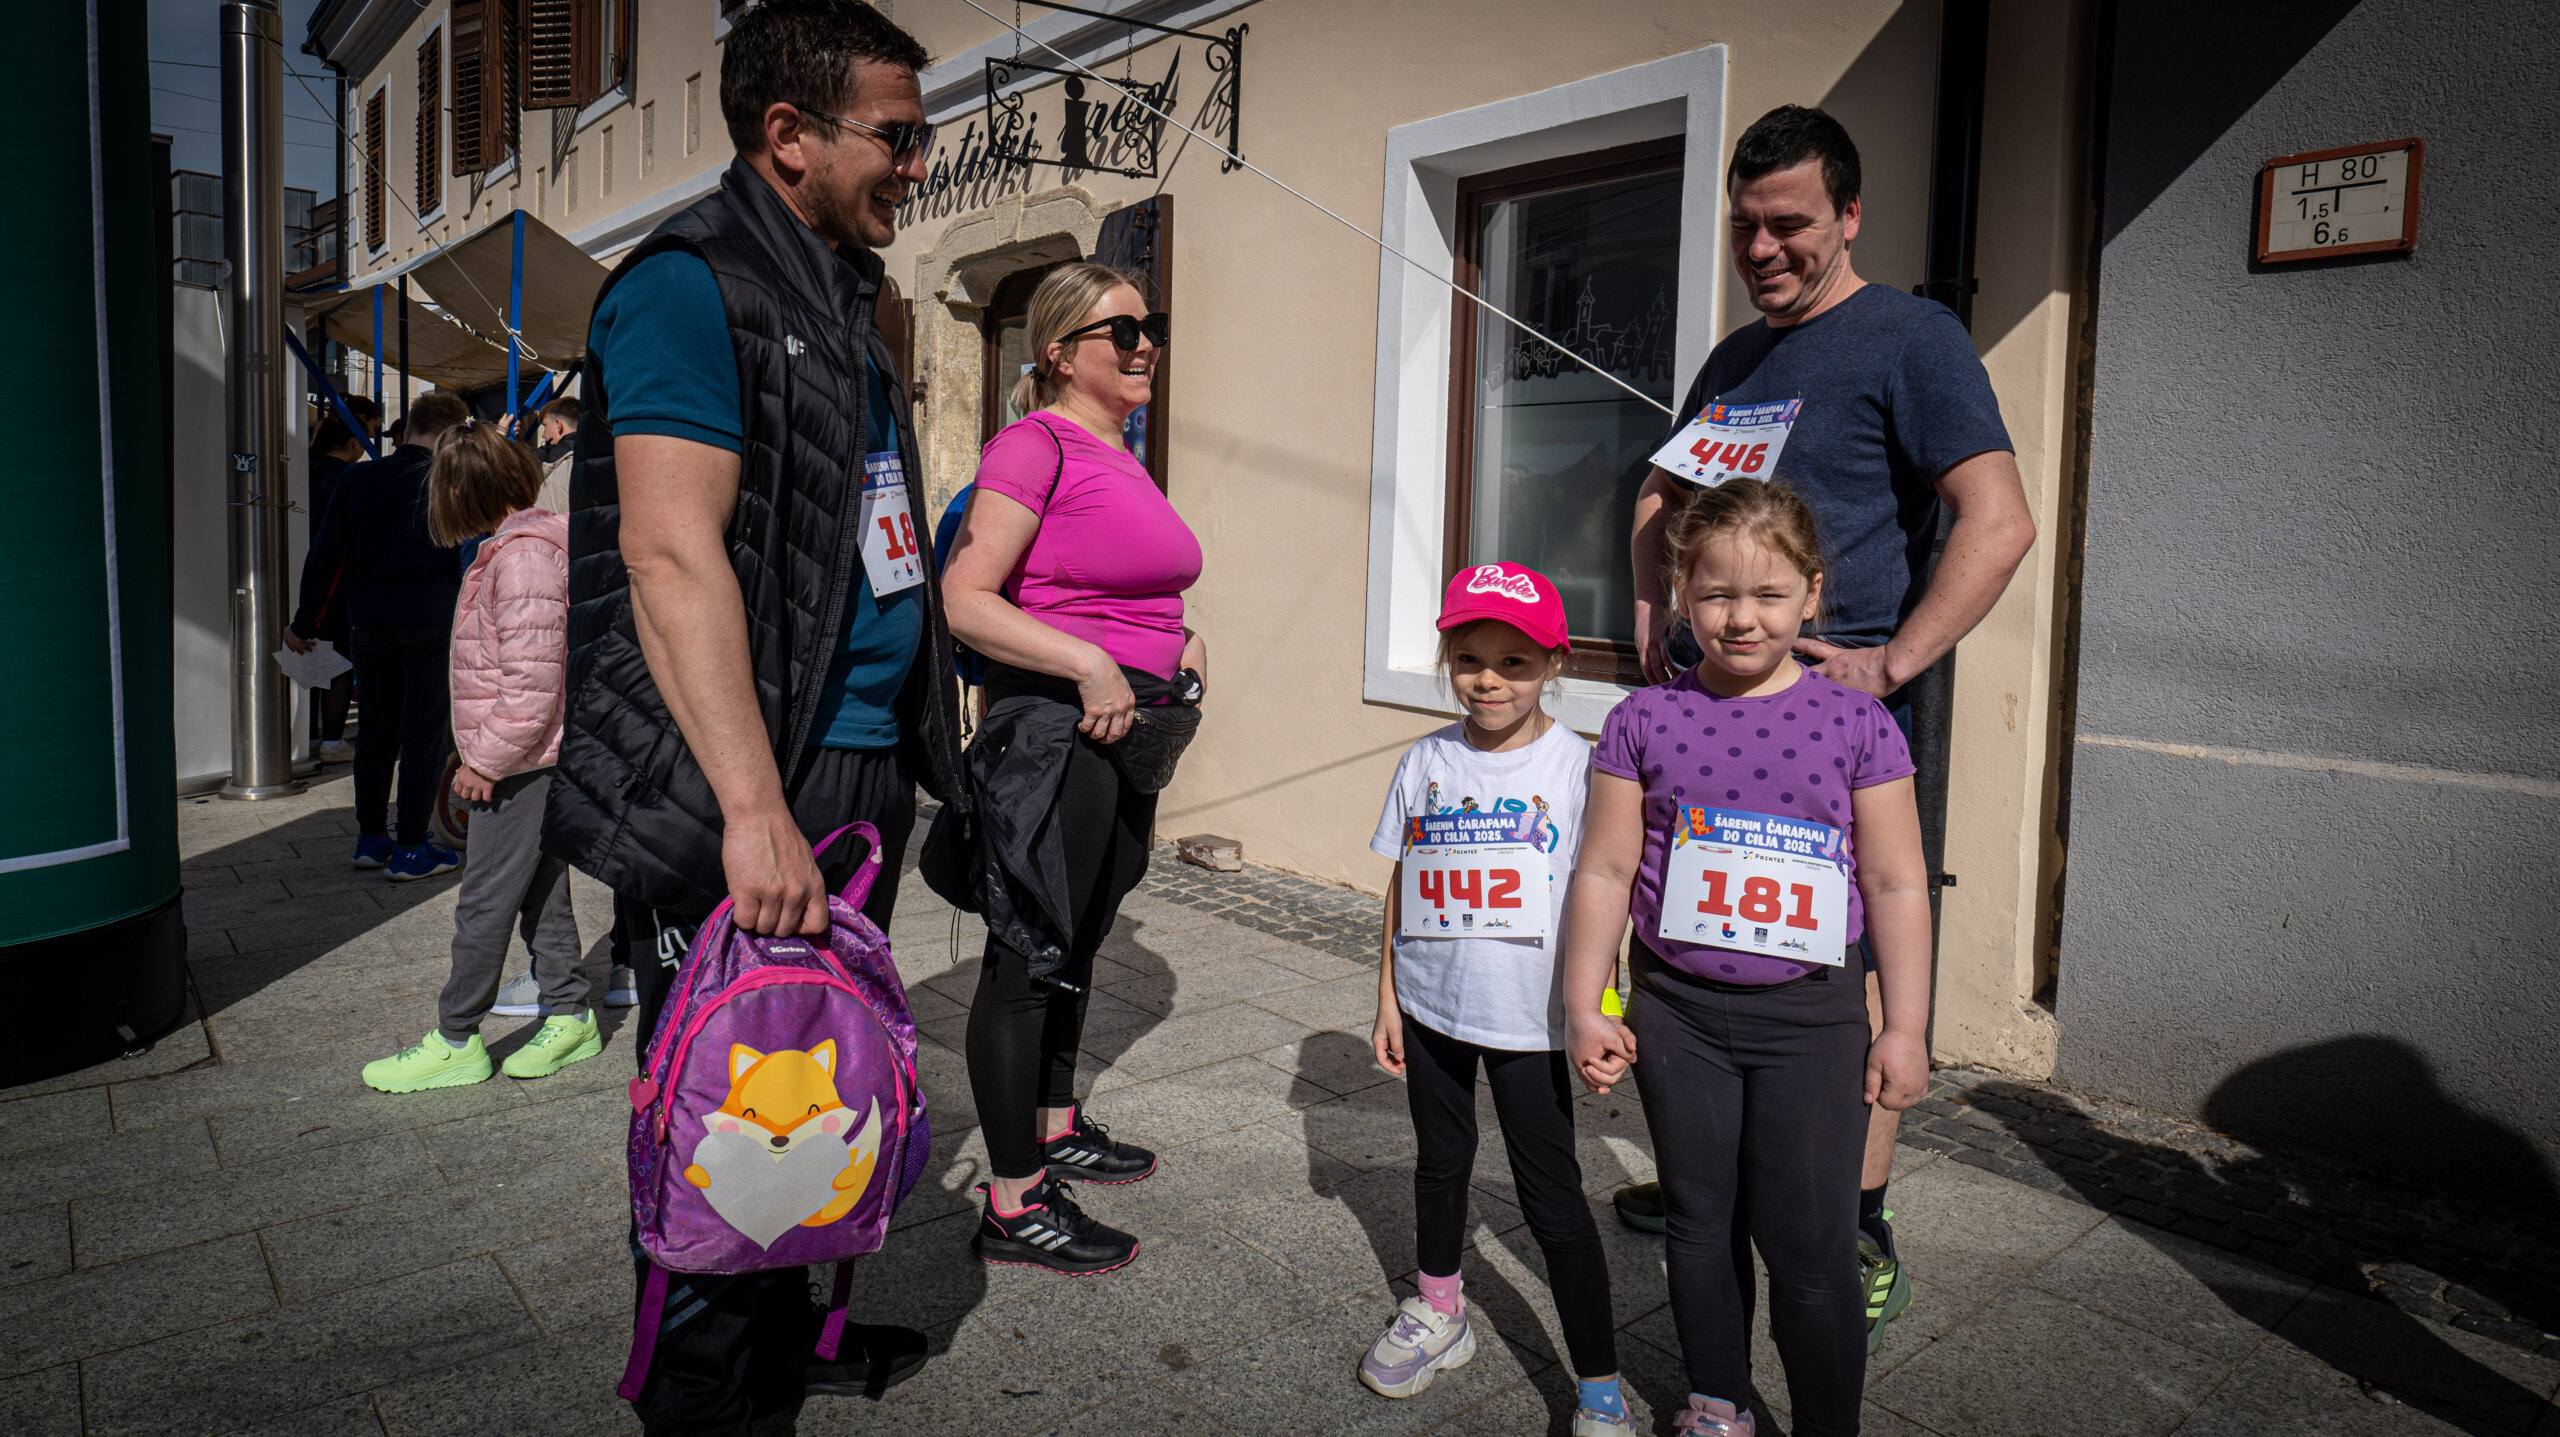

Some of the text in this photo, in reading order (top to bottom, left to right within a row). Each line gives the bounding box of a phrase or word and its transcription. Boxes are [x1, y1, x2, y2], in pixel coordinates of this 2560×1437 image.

[1058, 44, 1181, 154] red
[2302, 156, 2378, 187] H 80
[2297, 198, 2329, 221] 1,5
[2314, 222, 2349, 245] 6,6
[1728, 417, 1740, 425] DO
[1753, 404, 1785, 416] ČARAPAMA
[1690, 438, 1769, 473] 446
[874, 473, 885, 486] DO
[1471, 566, 1536, 598] Barbie
[1425, 816, 1516, 832] ŠARENIM ČARAPAMA
[1430, 830, 1504, 843] DO CILJA 2025.
[1714, 813, 1825, 844] ŠARENIM ČARAPAMA
[1722, 829, 1740, 843] DO
[1744, 832, 1779, 849] CILJA
[1783, 838, 1814, 855] 2025.
[1420, 868, 1522, 909] 442
[1697, 869, 1819, 931] 181
